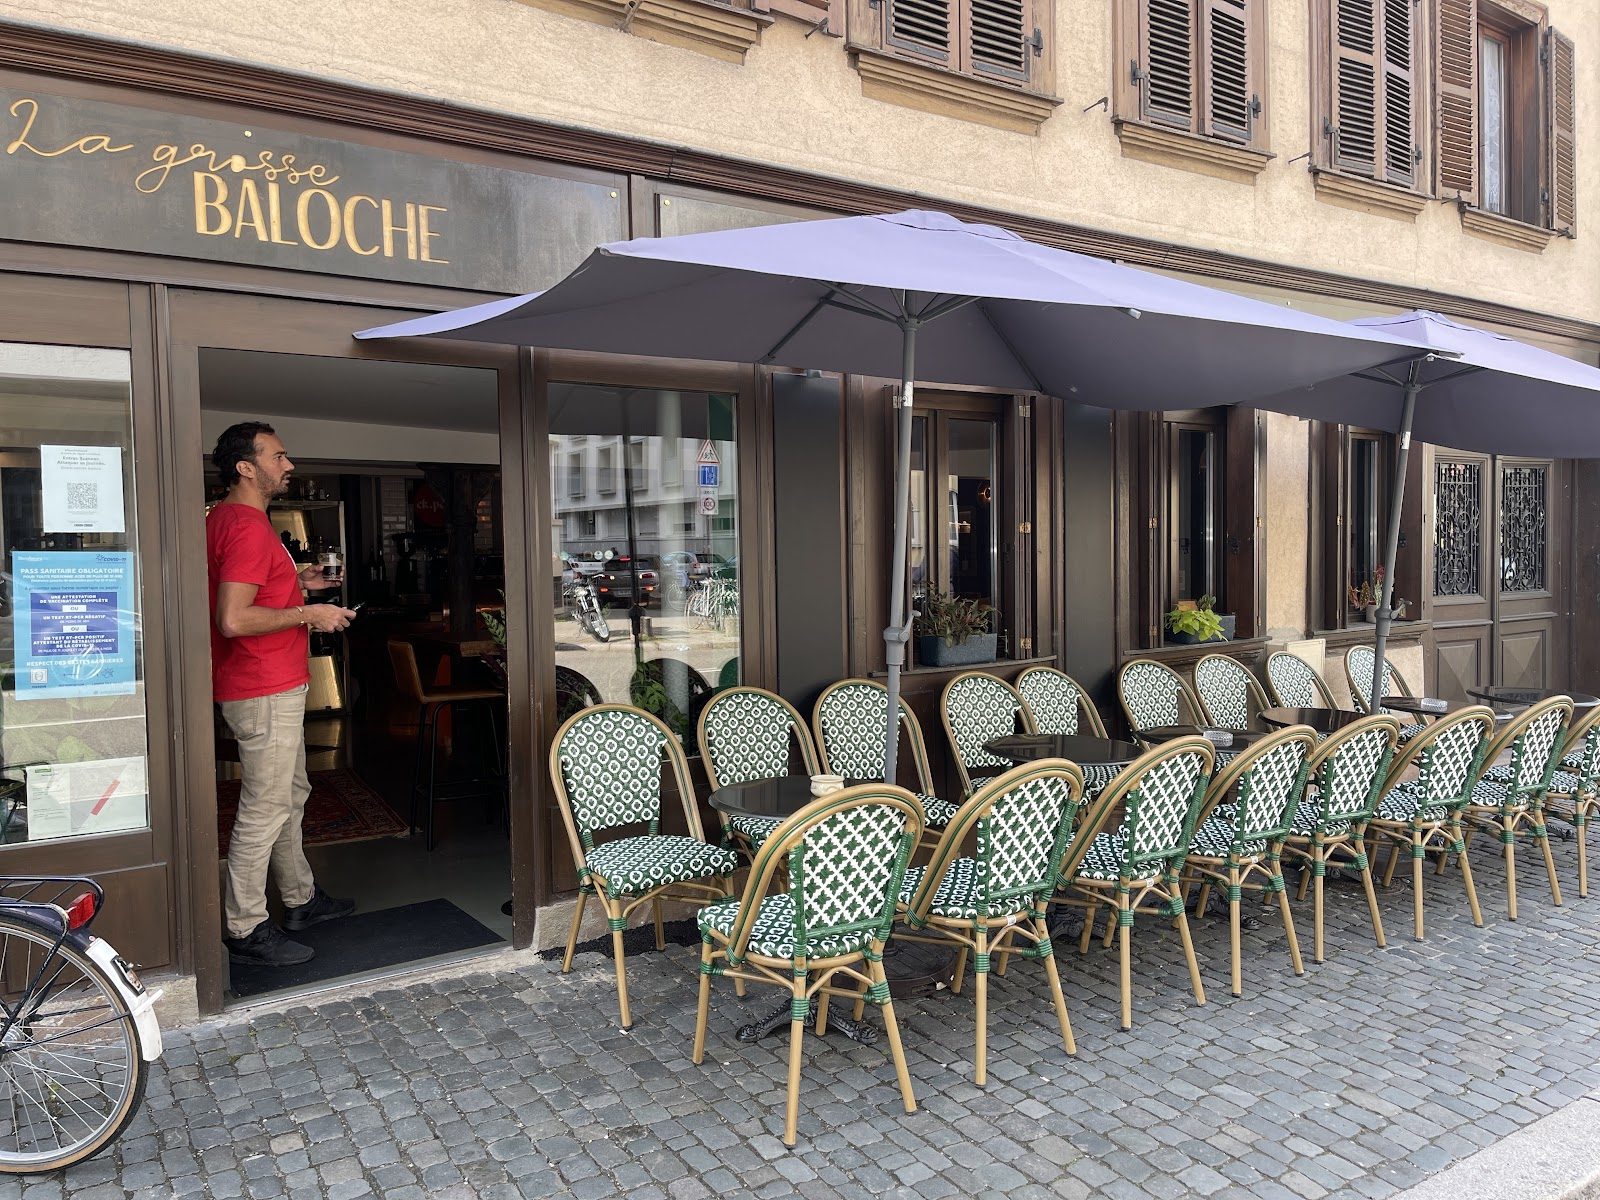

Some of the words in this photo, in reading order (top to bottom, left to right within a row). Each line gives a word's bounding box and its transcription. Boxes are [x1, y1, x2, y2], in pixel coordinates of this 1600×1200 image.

[7, 98, 135, 157] La
[134, 142, 340, 194] grosse
[193, 171, 451, 266] BALOCHE
